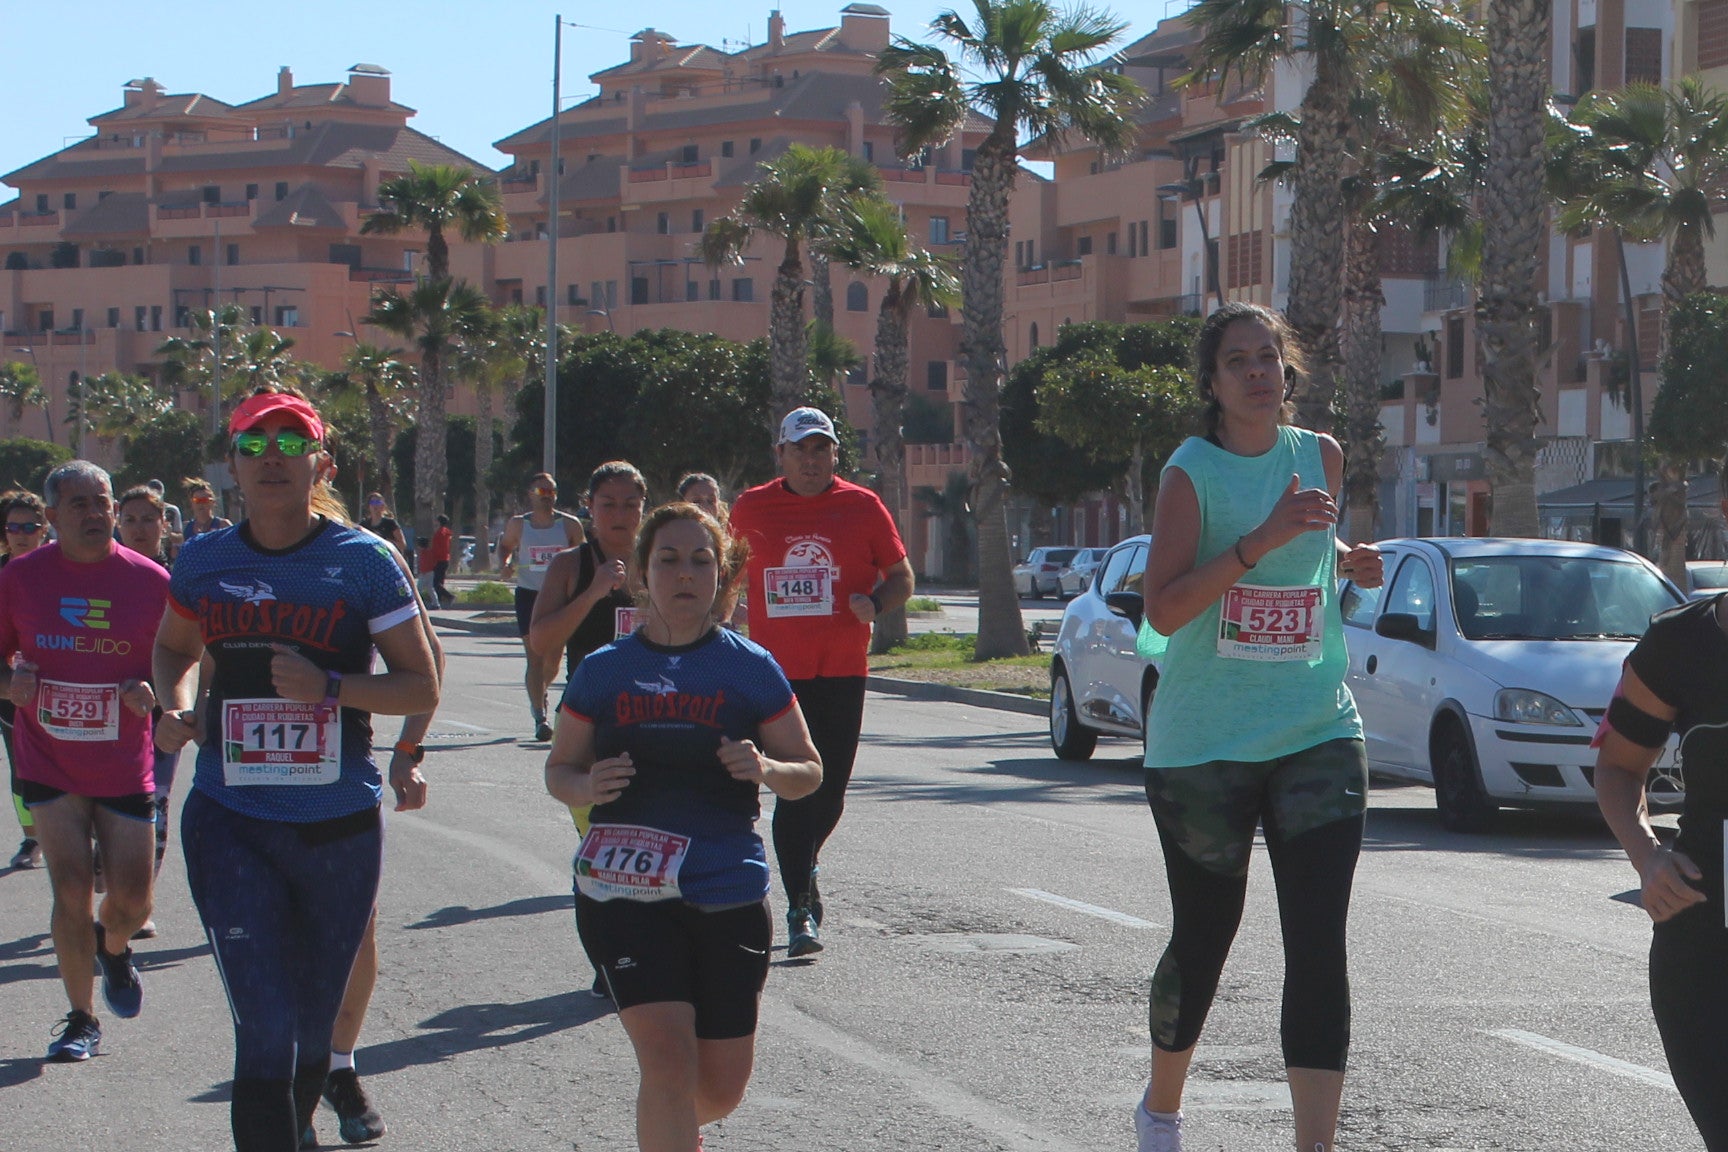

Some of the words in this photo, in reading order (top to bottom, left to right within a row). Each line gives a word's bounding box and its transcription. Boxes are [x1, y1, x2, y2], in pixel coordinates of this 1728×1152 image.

[781, 580, 813, 596] 148
[1282, 590, 1307, 598] POPULAR
[1241, 598, 1264, 606] CIUDAD
[1249, 609, 1299, 632] 523
[36, 633, 131, 655] RUNEJIDO
[57, 700, 97, 719] 529
[253, 704, 284, 712] CARRERA
[241, 713, 265, 721] CIUDAD
[278, 713, 314, 721] ROQUETAS
[252, 724, 309, 749] 117
[266, 753, 293, 762] RAQUEL
[604, 847, 654, 874] 176
